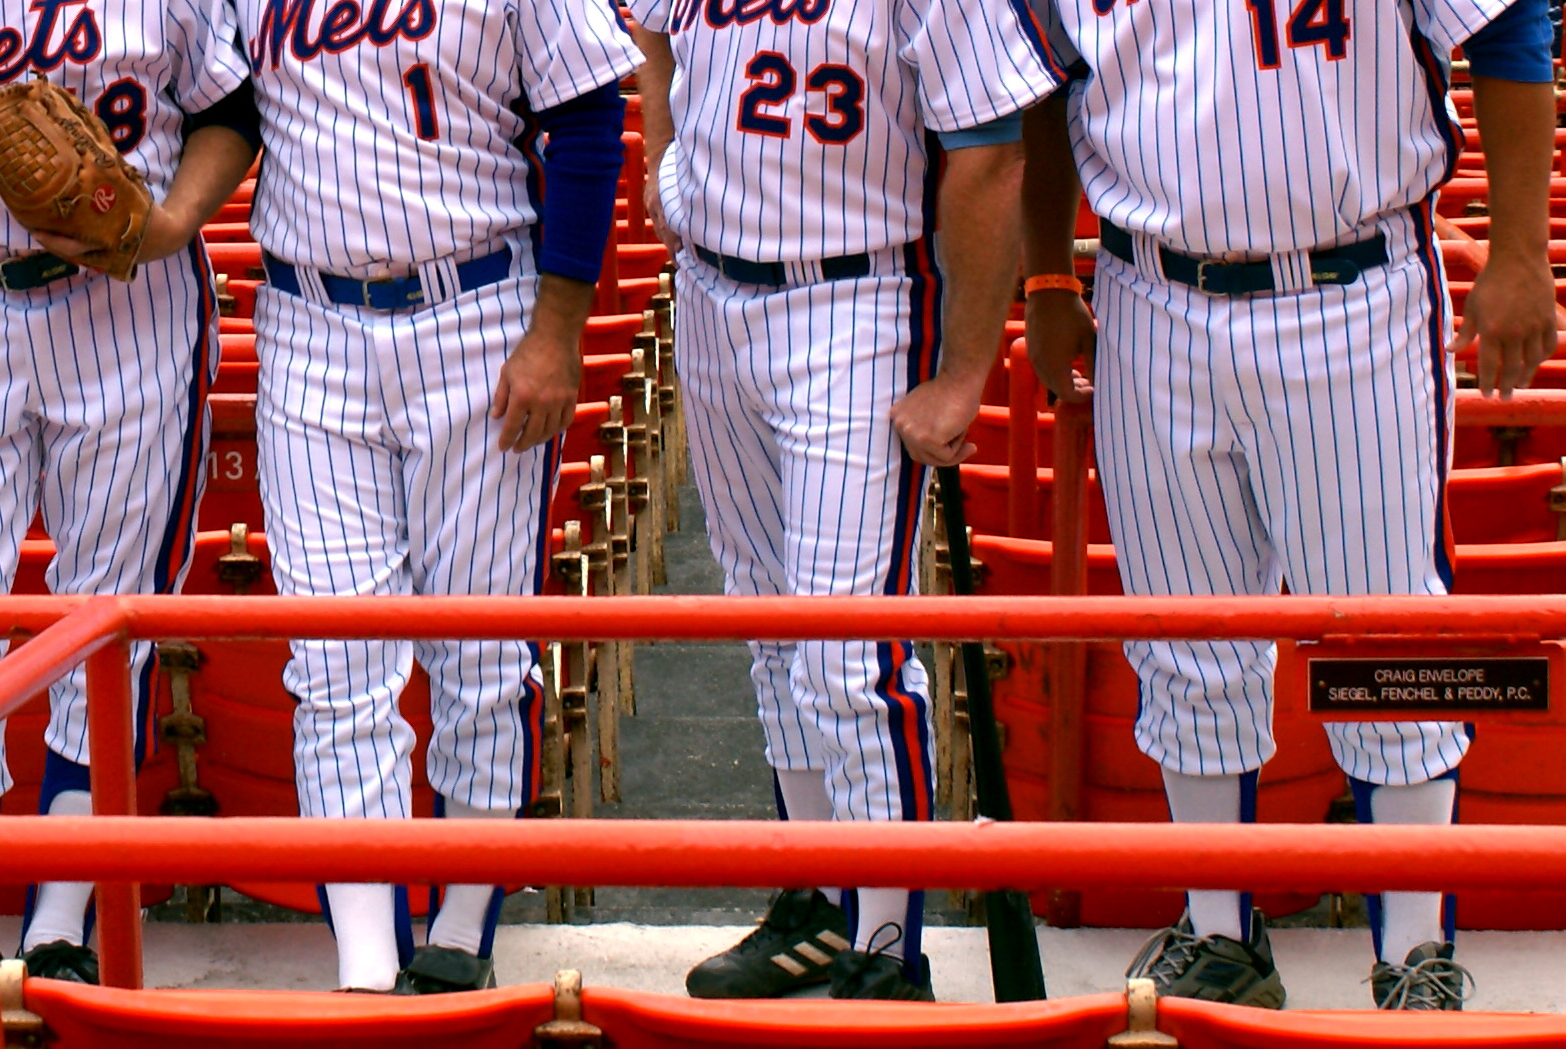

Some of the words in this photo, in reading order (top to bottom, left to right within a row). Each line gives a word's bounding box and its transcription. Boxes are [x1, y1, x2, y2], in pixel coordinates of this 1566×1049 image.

[65, 76, 147, 156] 8
[403, 63, 440, 142] 1
[736, 50, 865, 145] 23
[205, 451, 243, 480] 13
[1328, 687, 1377, 701] SIEGEL,
[1381, 688, 1438, 701] FENCHEL
[1444, 688, 1453, 700] &
[1458, 687, 1502, 701] PEDDY,
[1506, 687, 1531, 700] P.C.
[1374, 669, 1416, 683] CRAIG
[1419, 668, 1484, 682] ENVELOPE
